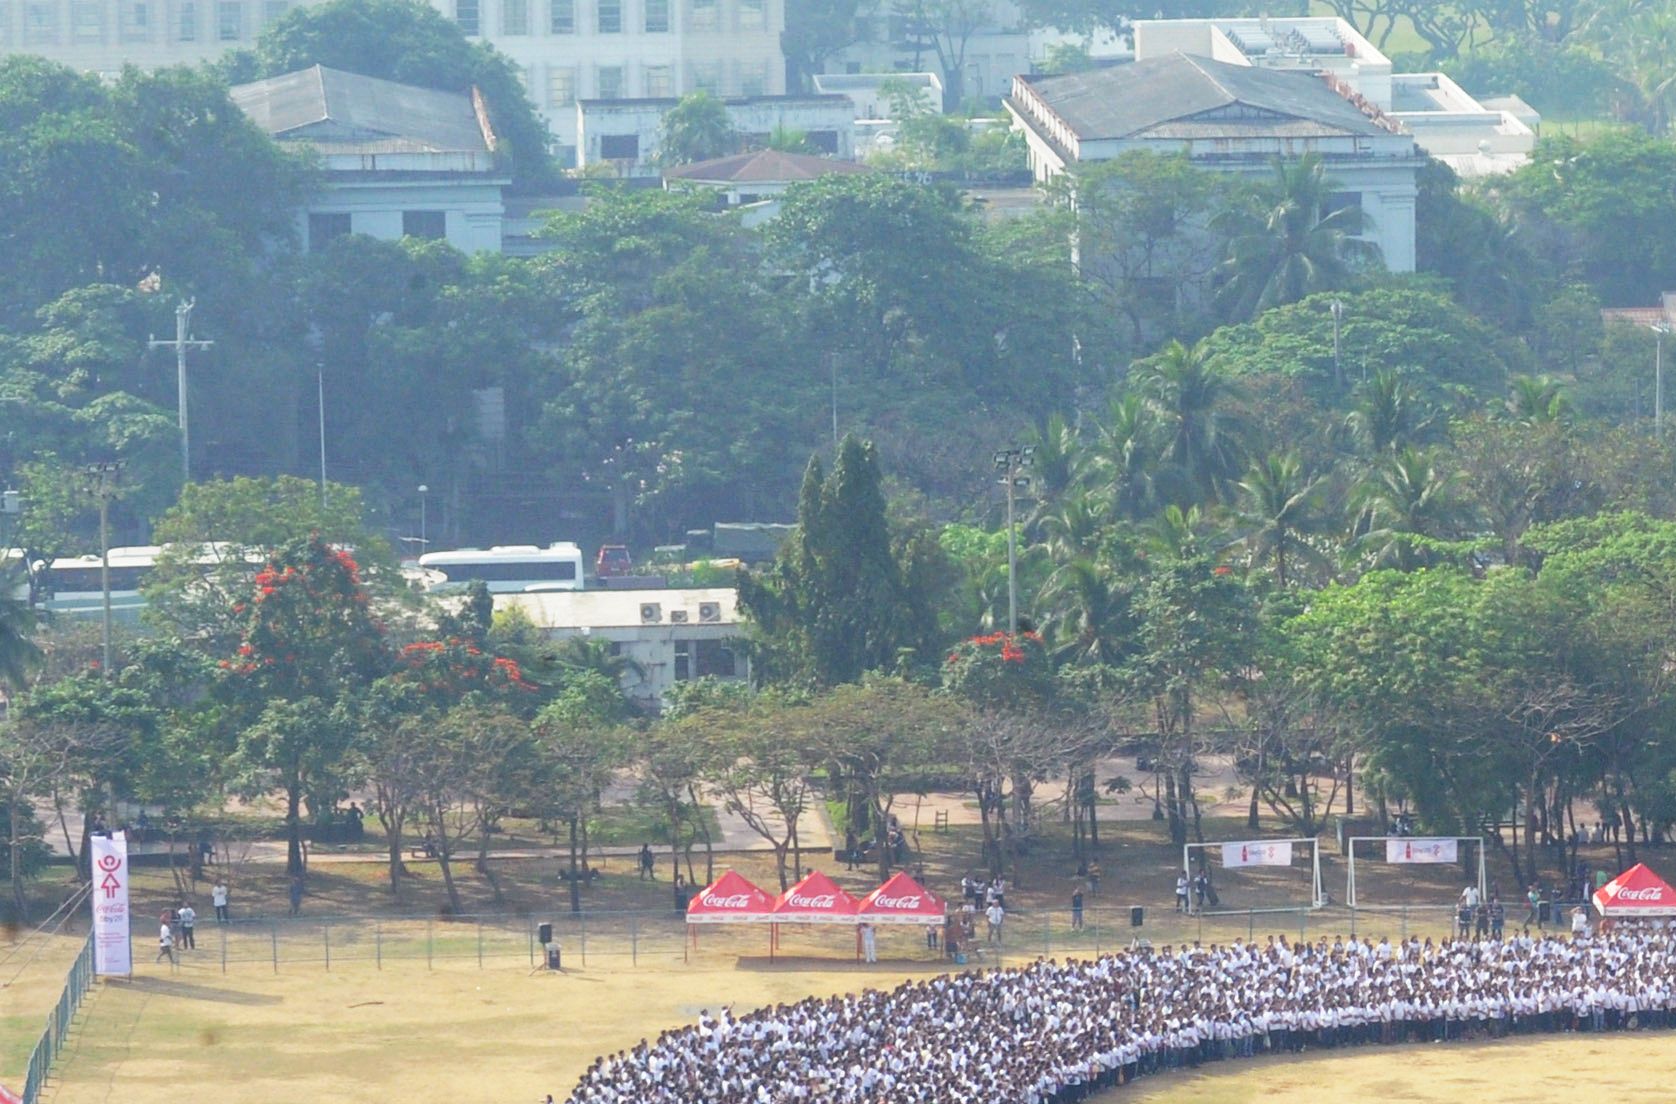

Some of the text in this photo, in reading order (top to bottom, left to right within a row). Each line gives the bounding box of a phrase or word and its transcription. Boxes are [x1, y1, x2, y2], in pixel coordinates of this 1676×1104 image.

[702, 893, 751, 908] Coca-Cola
[789, 893, 836, 908] Coca-Cola
[1617, 886, 1663, 901] Coca-Cola
[874, 894, 921, 909] Coca-Cola
